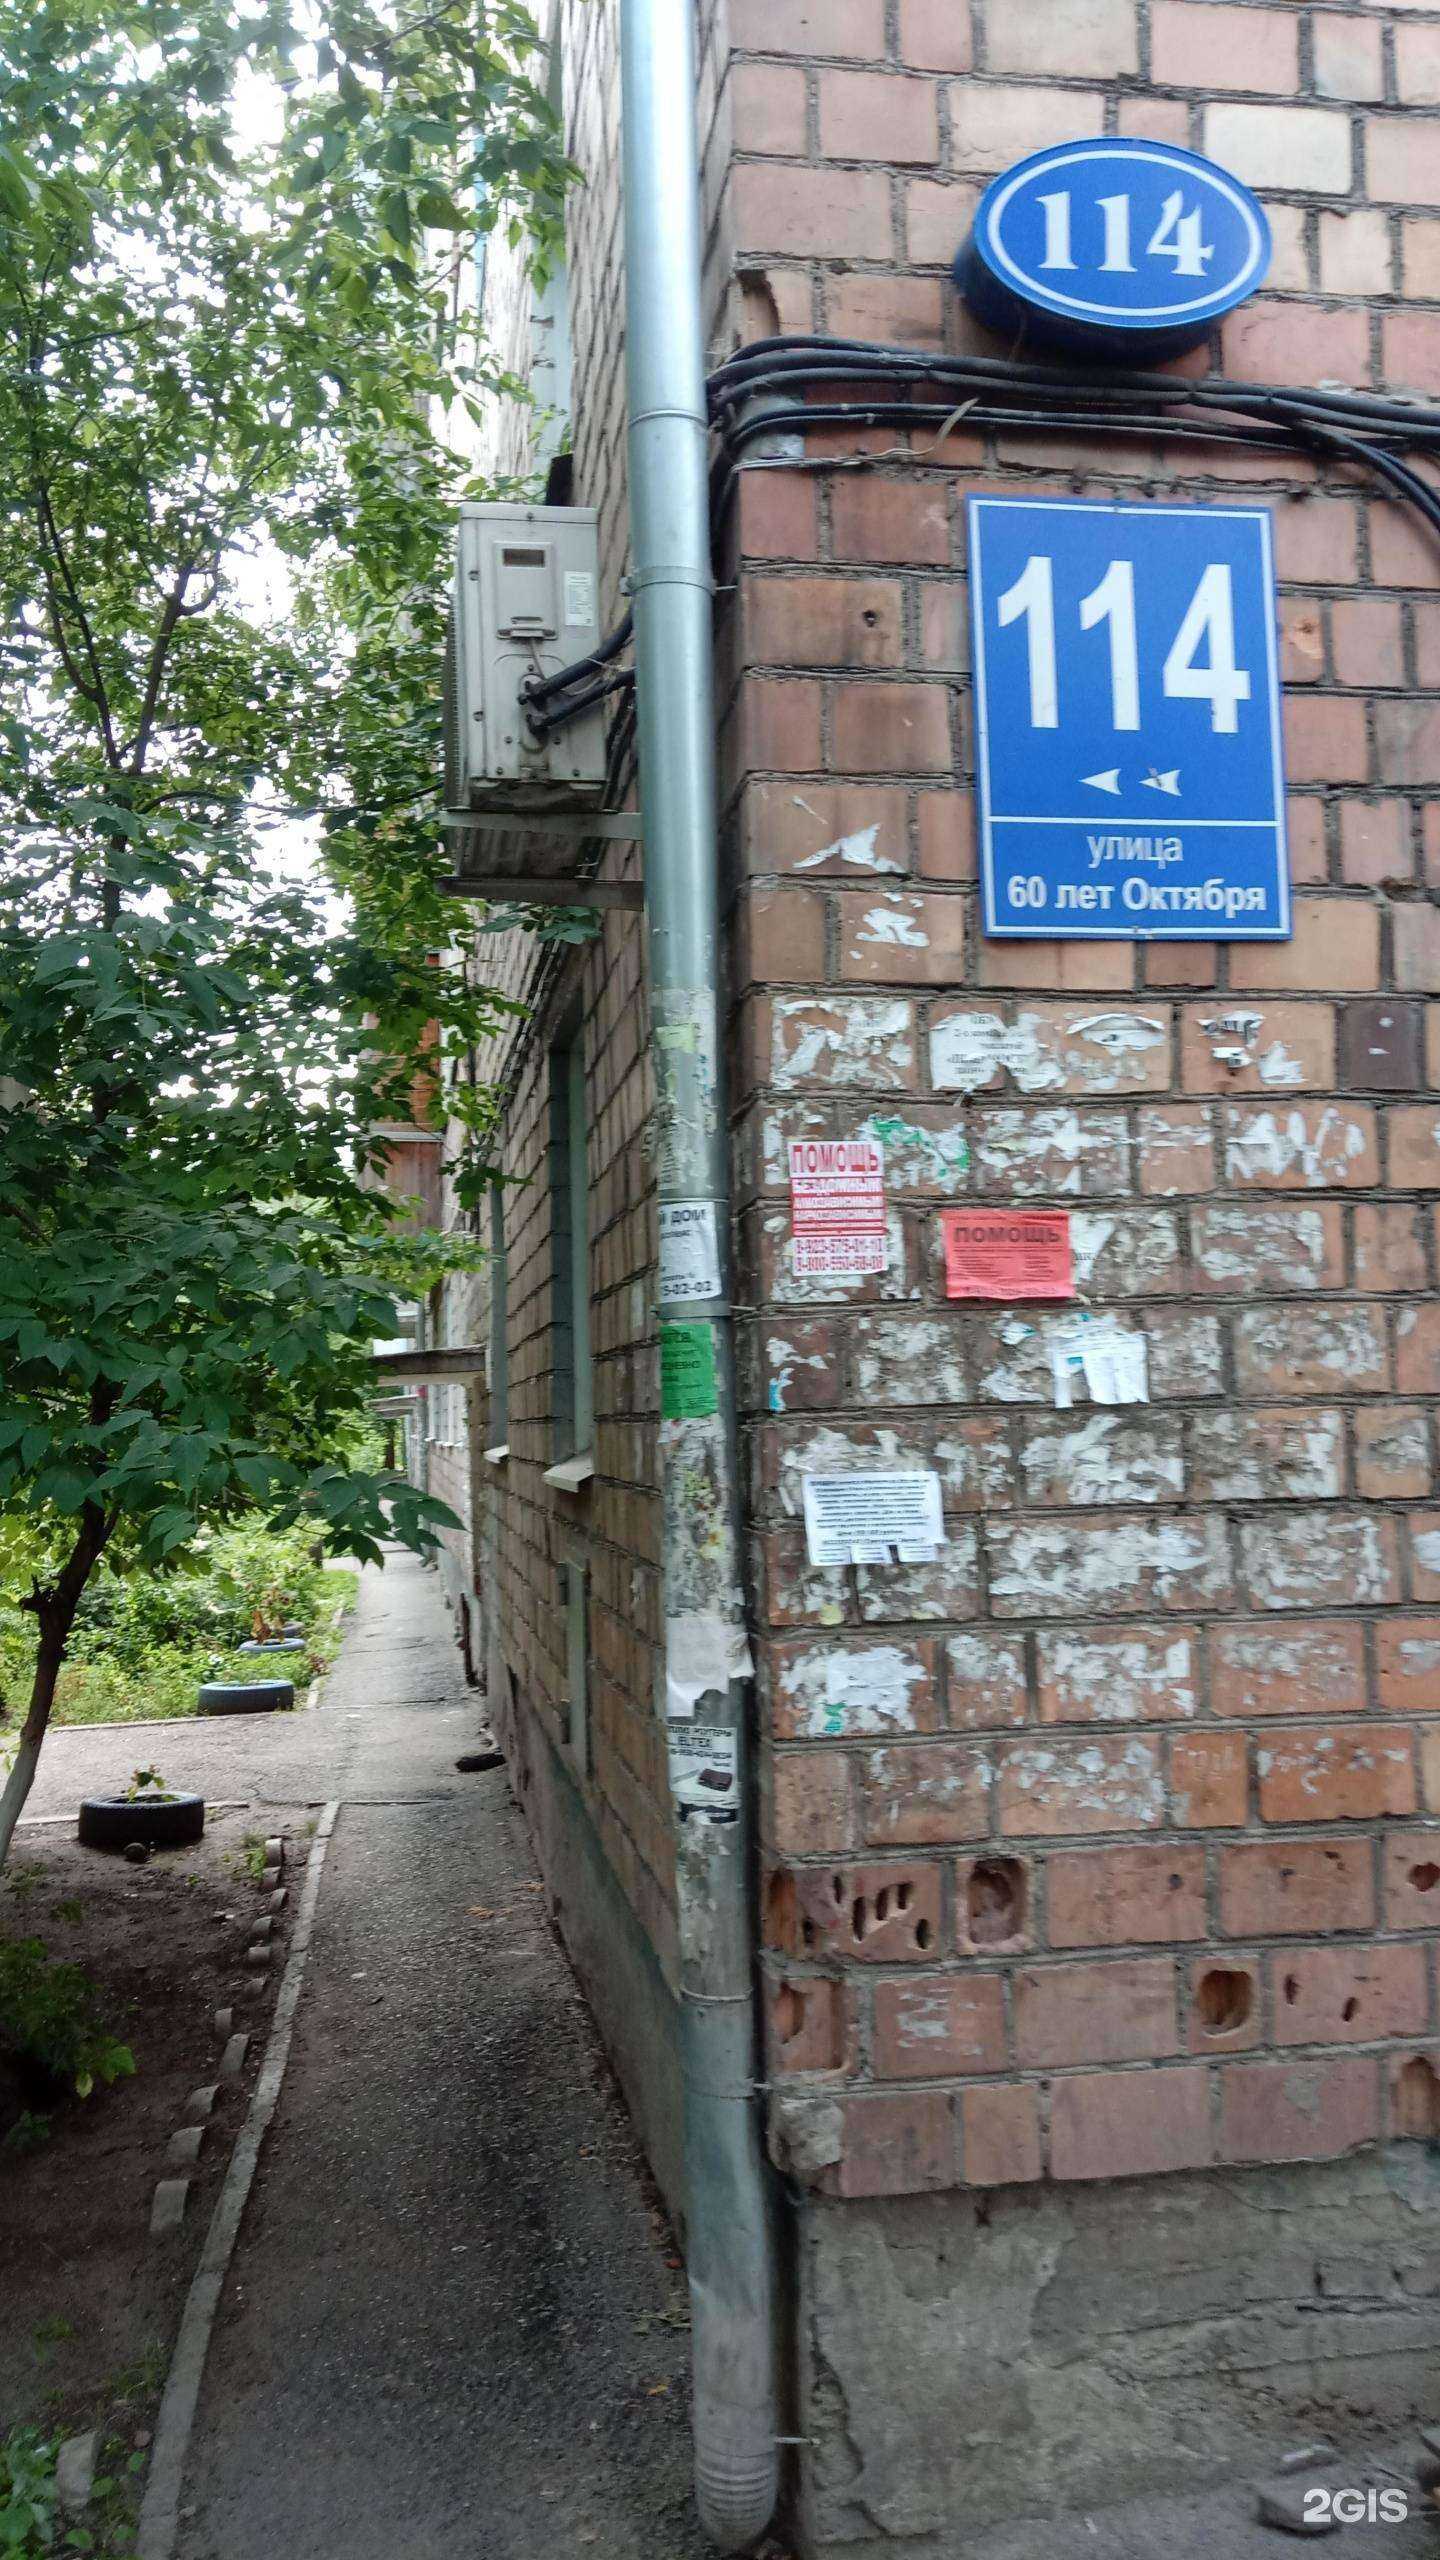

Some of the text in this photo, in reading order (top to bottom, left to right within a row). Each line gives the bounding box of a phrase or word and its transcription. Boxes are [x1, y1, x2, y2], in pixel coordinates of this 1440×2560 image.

[1034, 189, 1216, 277] 114
[997, 556, 1252, 734] 114
[1086, 834, 1184, 869] улица
[1007, 875, 1267, 918] 60 лет Октября
[792, 1144, 879, 1173] ПОМОЩЬ
[954, 1226, 1061, 1244] ПОМОЩЬ
